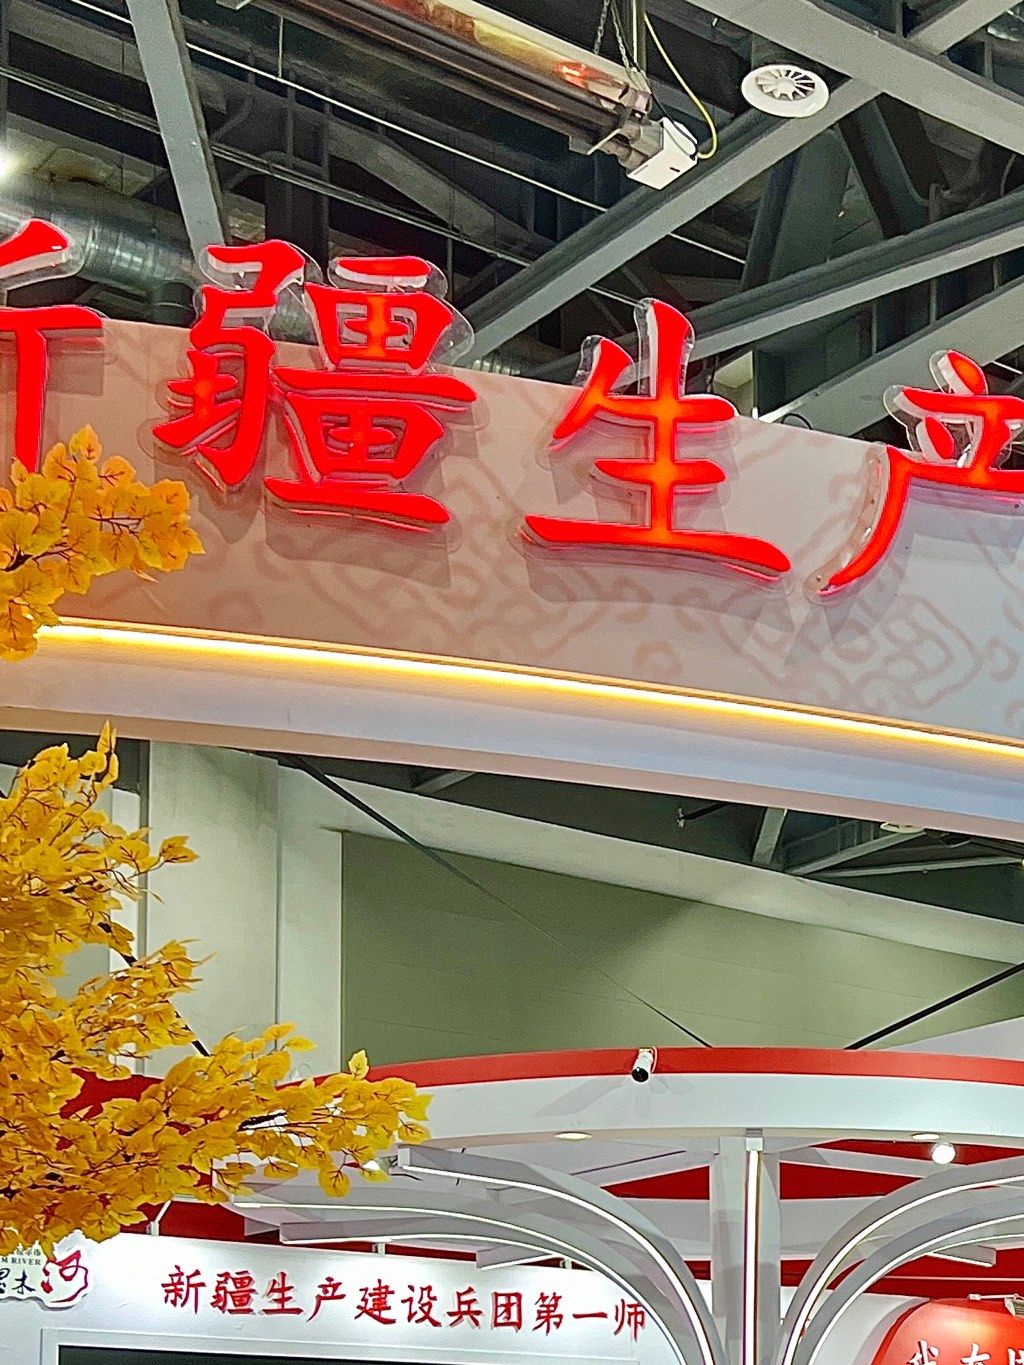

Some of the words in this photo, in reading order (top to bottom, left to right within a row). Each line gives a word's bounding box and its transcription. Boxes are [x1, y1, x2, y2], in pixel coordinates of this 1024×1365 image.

[161, 1264, 646, 1343] 新疆生产建设兵团第一师
